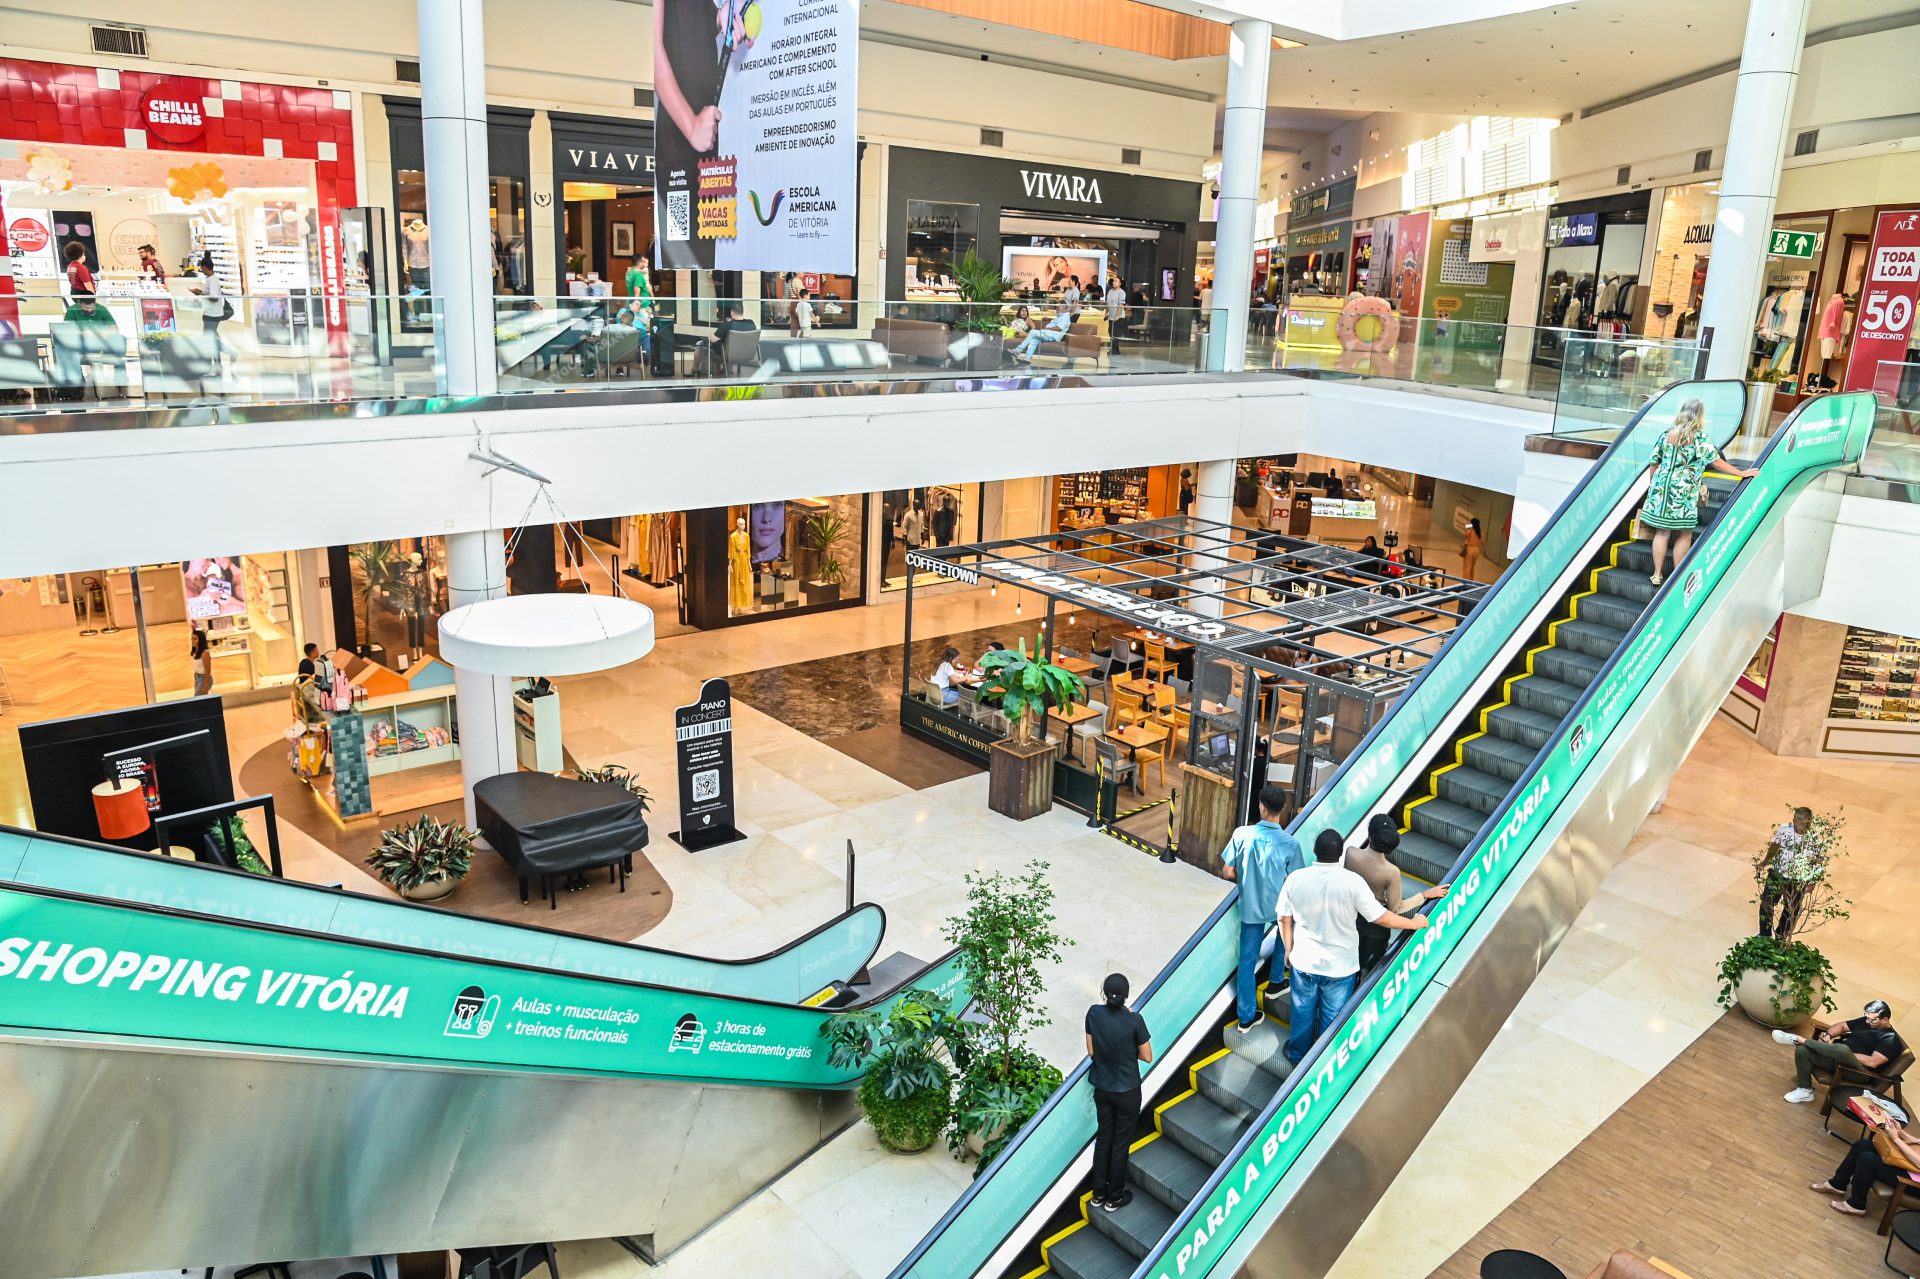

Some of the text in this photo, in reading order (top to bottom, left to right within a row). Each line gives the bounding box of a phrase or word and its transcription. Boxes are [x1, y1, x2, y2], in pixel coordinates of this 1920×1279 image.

[783, 4, 839, 26] INTERNACIONAL
[771, 26, 838, 51] HORÁRIO INTEGRAL
[739, 42, 837, 72] AMERICANO E COMPLEMENTO
[769, 59, 837, 80] COM AFTER SCHOOL
[750, 91, 779, 105] IMERSÃO
[779, 90, 790, 100] EM
[817, 79, 837, 94] ALÉM
[149, 99, 199, 114] CHILLI
[749, 97, 837, 119] DAS AULAS EM PORTUGUÊS
[148, 111, 203, 126] BEANS
[763, 120, 837, 138] EMPREENDEDORISMO
[754, 134, 835, 153] AMBIENTE DE INOVAÇÃO
[700, 164, 733, 177] MATRÍCULAS
[700, 176, 733, 189] ABERTAS
[1020, 169, 1103, 204] VIVARA
[789, 185, 820, 198] ESCOLA
[701, 206, 728, 219] VAGAS
[788, 200, 837, 213] AMERICANA
[701, 219, 728, 228] LIMITADAS
[788, 215, 829, 229] DE VITÓRIA
[1571, 229, 1576, 237] a
[1576, 223, 1593, 237] Mano
[796, 231, 808, 239] Learn
[1683, 223, 1715, 244] ACQUA
[1882, 251, 1916, 263] TODA
[1880, 265, 1913, 277] LOJA
[1862, 295, 1912, 332] 50
[1893, 308, 1902, 320] %
[1861, 331, 1905, 341] DE DESCONTO
[906, 553, 978, 585] COFFEETOWN
[1597, 680, 1618, 711] Aulas
[1622, 616, 1664, 676] musculação
[1602, 681, 1627, 717] treinos
[1627, 633, 1663, 684] funcionais
[700, 699, 726, 712] PIANO
[681, 708, 726, 725] IN CONCERT
[921, 716, 935, 728] THE
[934, 723, 968, 743] AMERICAN
[115, 757, 142, 766] SUCESSO
[119, 766, 141, 774] AGORA
[0, 936, 410, 1019] SHOPPING VITÓRIA
[940, 984, 946, 992] a
[510, 996, 552, 1015] Aulas
[562, 1003, 640, 1026] musculação
[513, 1020, 563, 1039] treinos
[563, 1023, 630, 1045] funcionais
[715, 1020, 766, 1037] 3 horas de
[1175, 774, 1551, 1275] PARA A BODYTECH SHOPPING VITÓRIA
[708, 1038, 813, 1060] estacionamento grátis
